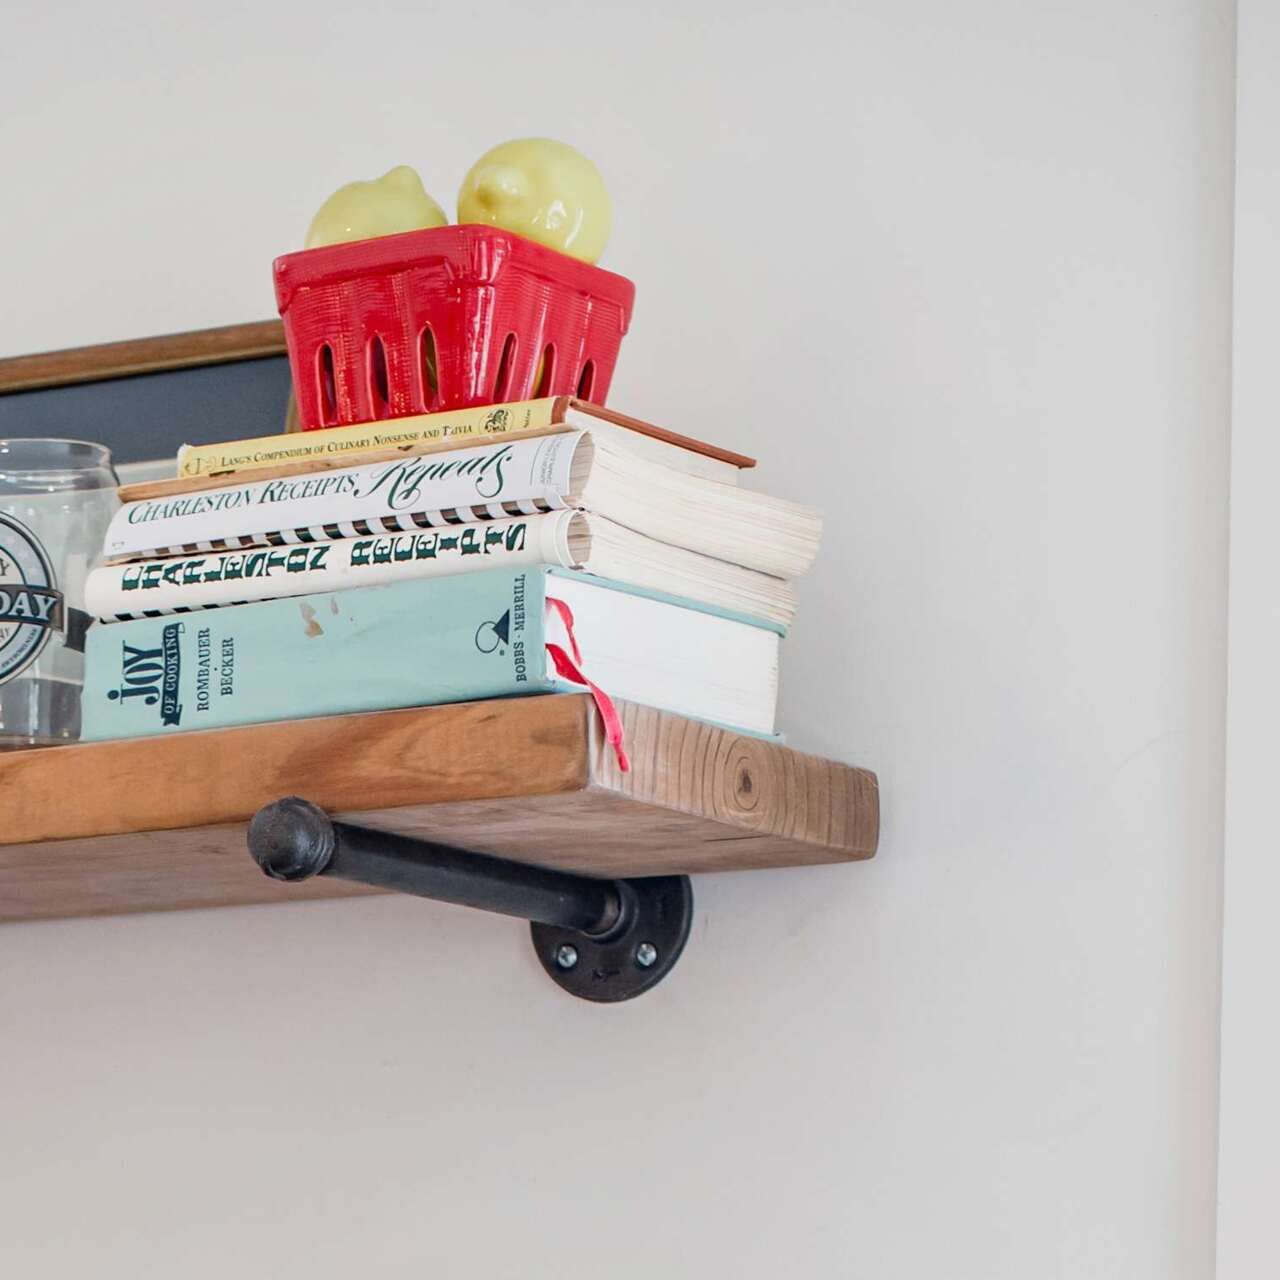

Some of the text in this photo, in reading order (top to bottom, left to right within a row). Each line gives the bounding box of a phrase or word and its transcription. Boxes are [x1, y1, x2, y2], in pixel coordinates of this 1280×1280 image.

[253, 446, 312, 462] COMPENDIUM
[327, 438, 371, 453] CULINARY
[373, 431, 419, 446] NONSENSE
[422, 428, 439, 439] AND
[127, 485, 255, 526] CHARLESTON
[120, 522, 528, 592] CHARLESTON RECEIPTS
[164, 628, 178, 714] OF COOKING
[196, 627, 210, 712] ROMBAUER
[220, 637, 234, 696] BECKER
[513, 641, 527, 682] BOBBS
